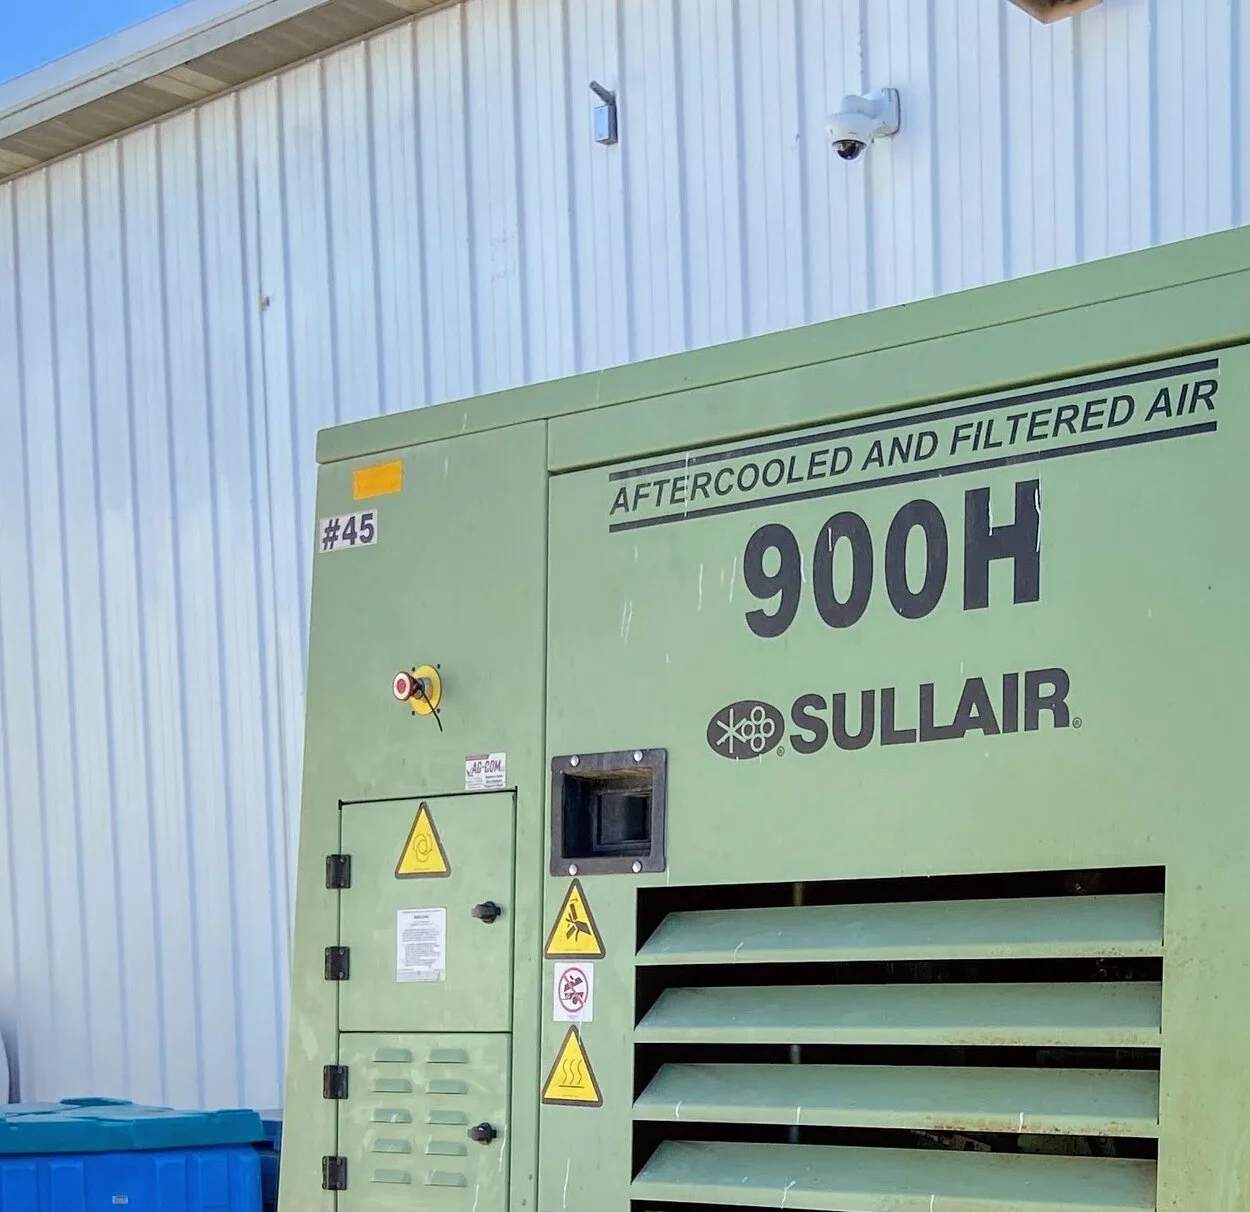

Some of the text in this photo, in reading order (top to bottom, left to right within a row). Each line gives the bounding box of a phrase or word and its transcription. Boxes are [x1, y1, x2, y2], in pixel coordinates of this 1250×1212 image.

[610, 379, 1219, 515] AFTERCOOLED AND FILTERED AIR
[322, 512, 375, 550] #45
[743, 479, 1040, 638] 900H
[790, 667, 1071, 754] SULLAIR
